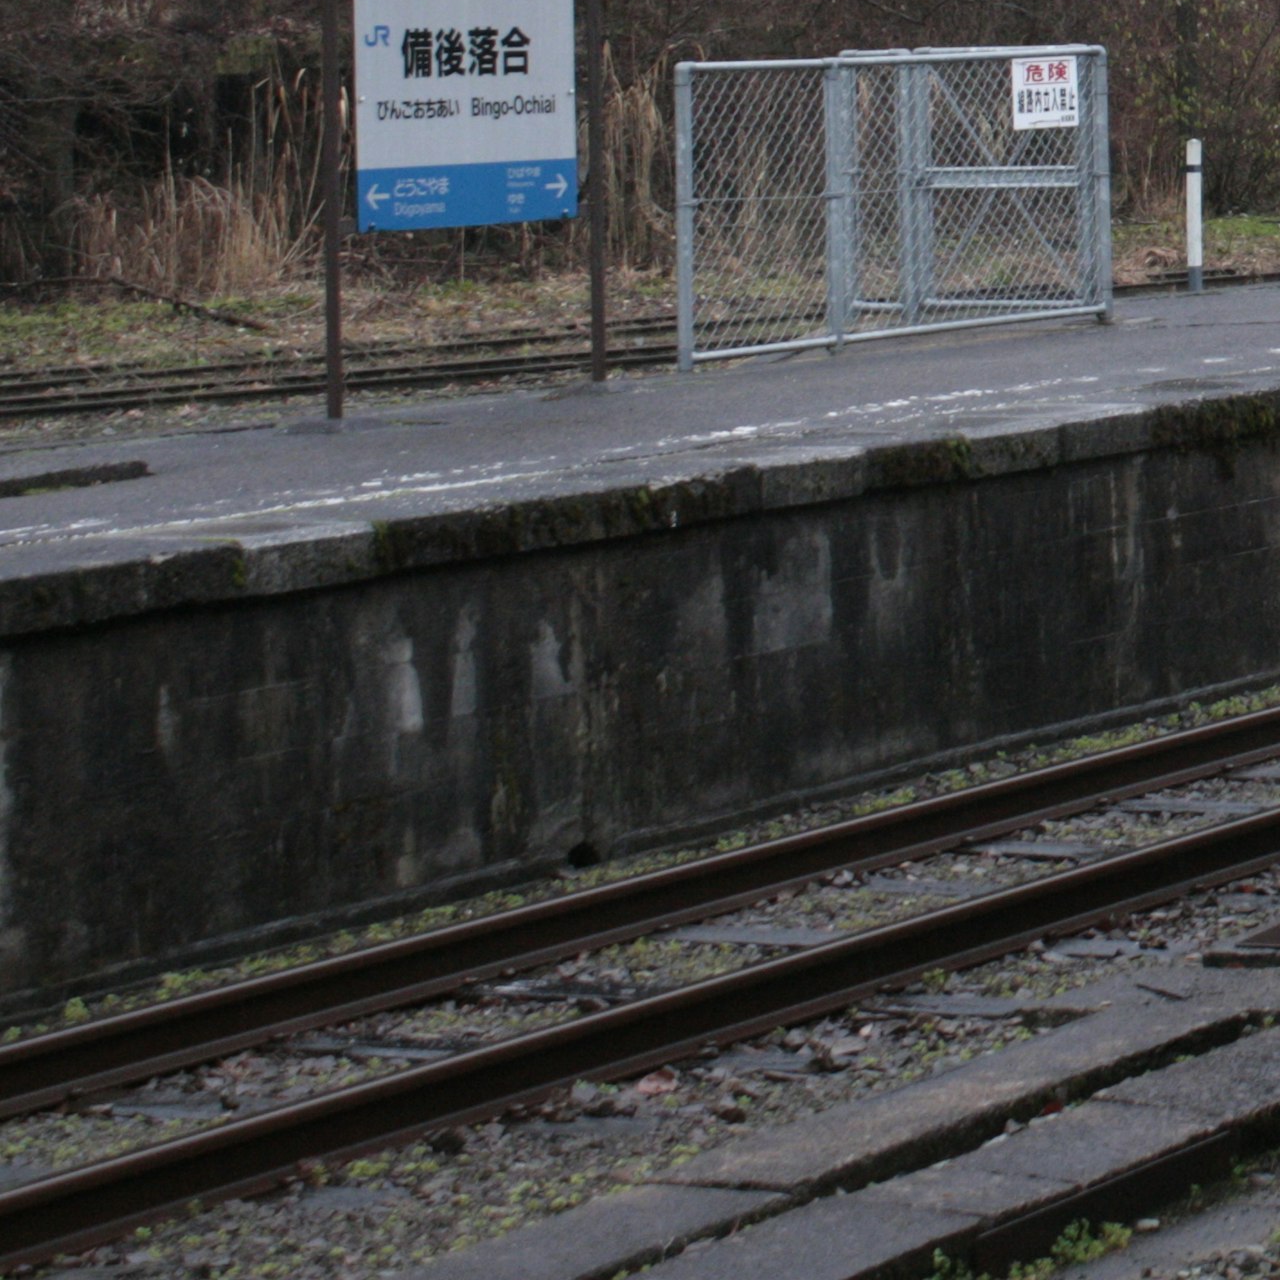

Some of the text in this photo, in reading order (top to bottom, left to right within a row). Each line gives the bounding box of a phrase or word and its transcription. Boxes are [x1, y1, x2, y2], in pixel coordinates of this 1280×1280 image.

[364, 24, 391, 48] JR
[401, 26, 532, 79] 備後落合
[1025, 61, 1069, 83] 危険
[376, 95, 557, 121] びんごおちあい Bingo-Ochiai
[1017, 87, 1076, 114] 線路内立入禁止
